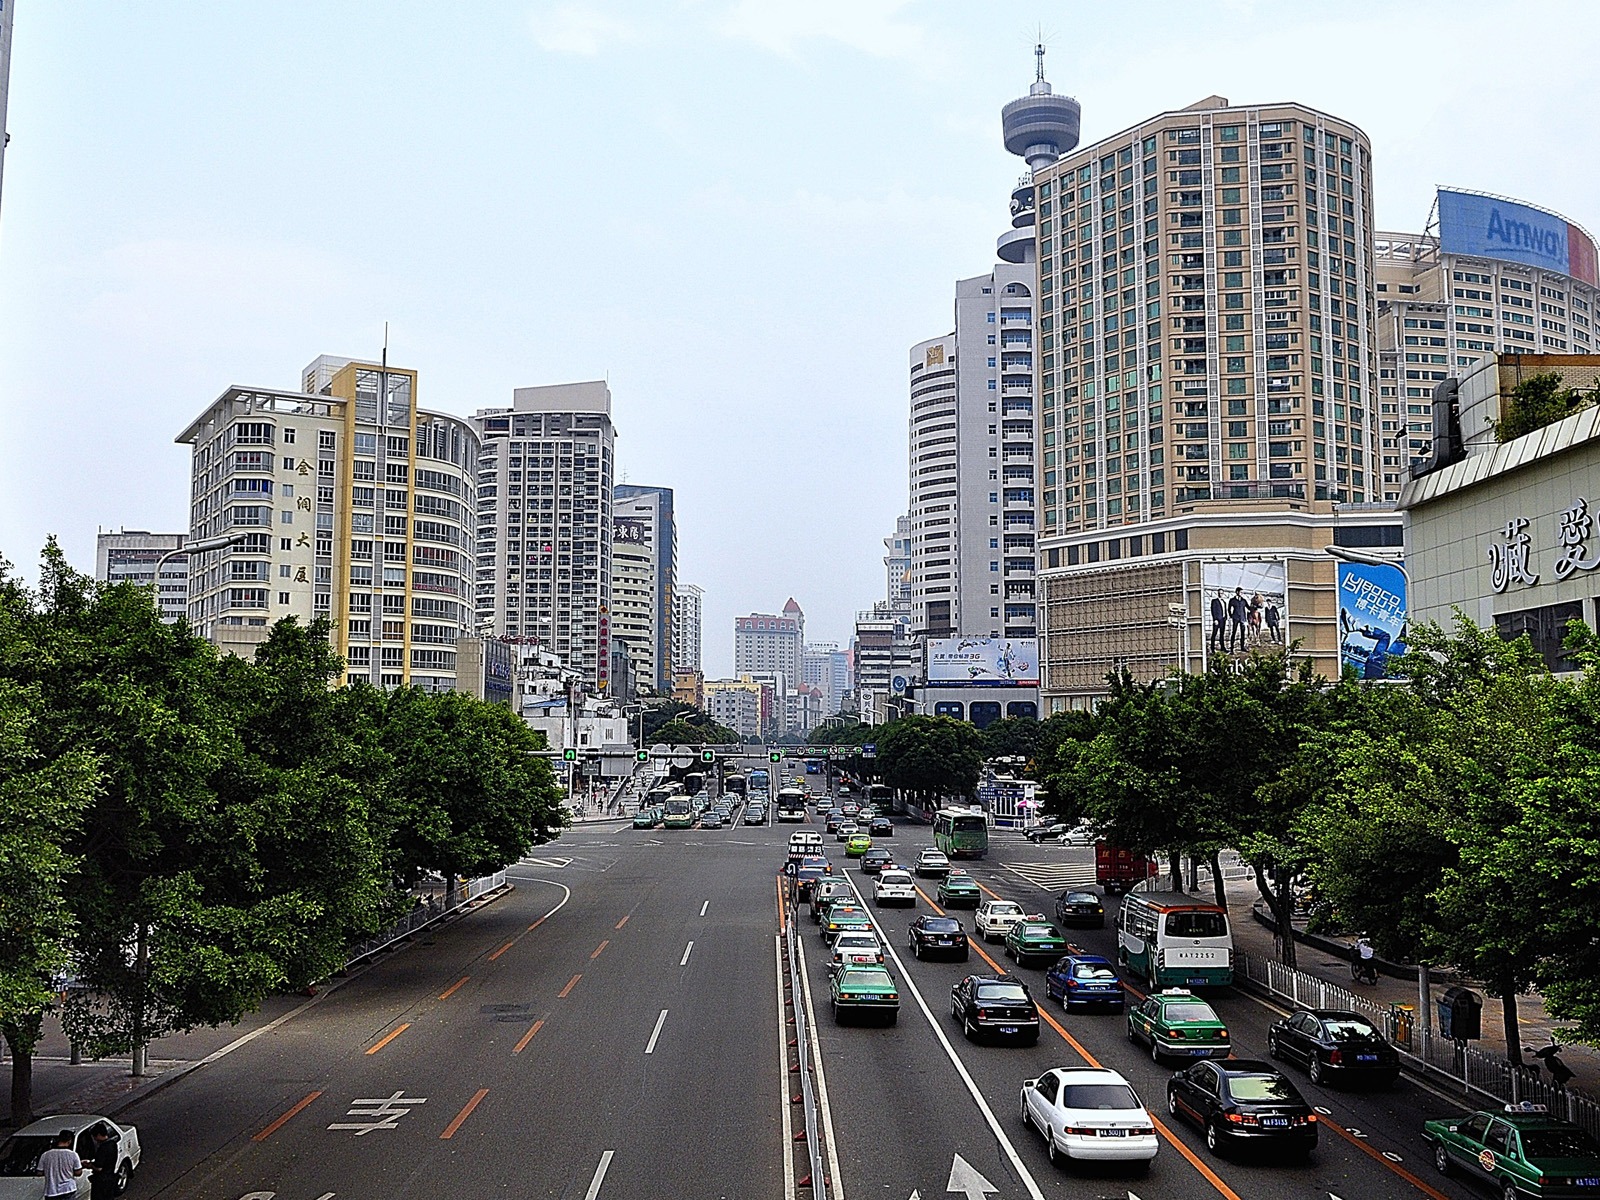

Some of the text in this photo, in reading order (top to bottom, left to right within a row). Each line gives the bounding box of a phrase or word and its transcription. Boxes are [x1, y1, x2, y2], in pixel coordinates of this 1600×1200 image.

[1486, 207, 1565, 266] Amway
[1360, 588, 1406, 619] YOUTH
[1362, 580, 1401, 606] BOCO
[1354, 598, 1401, 627] 博卡青年
